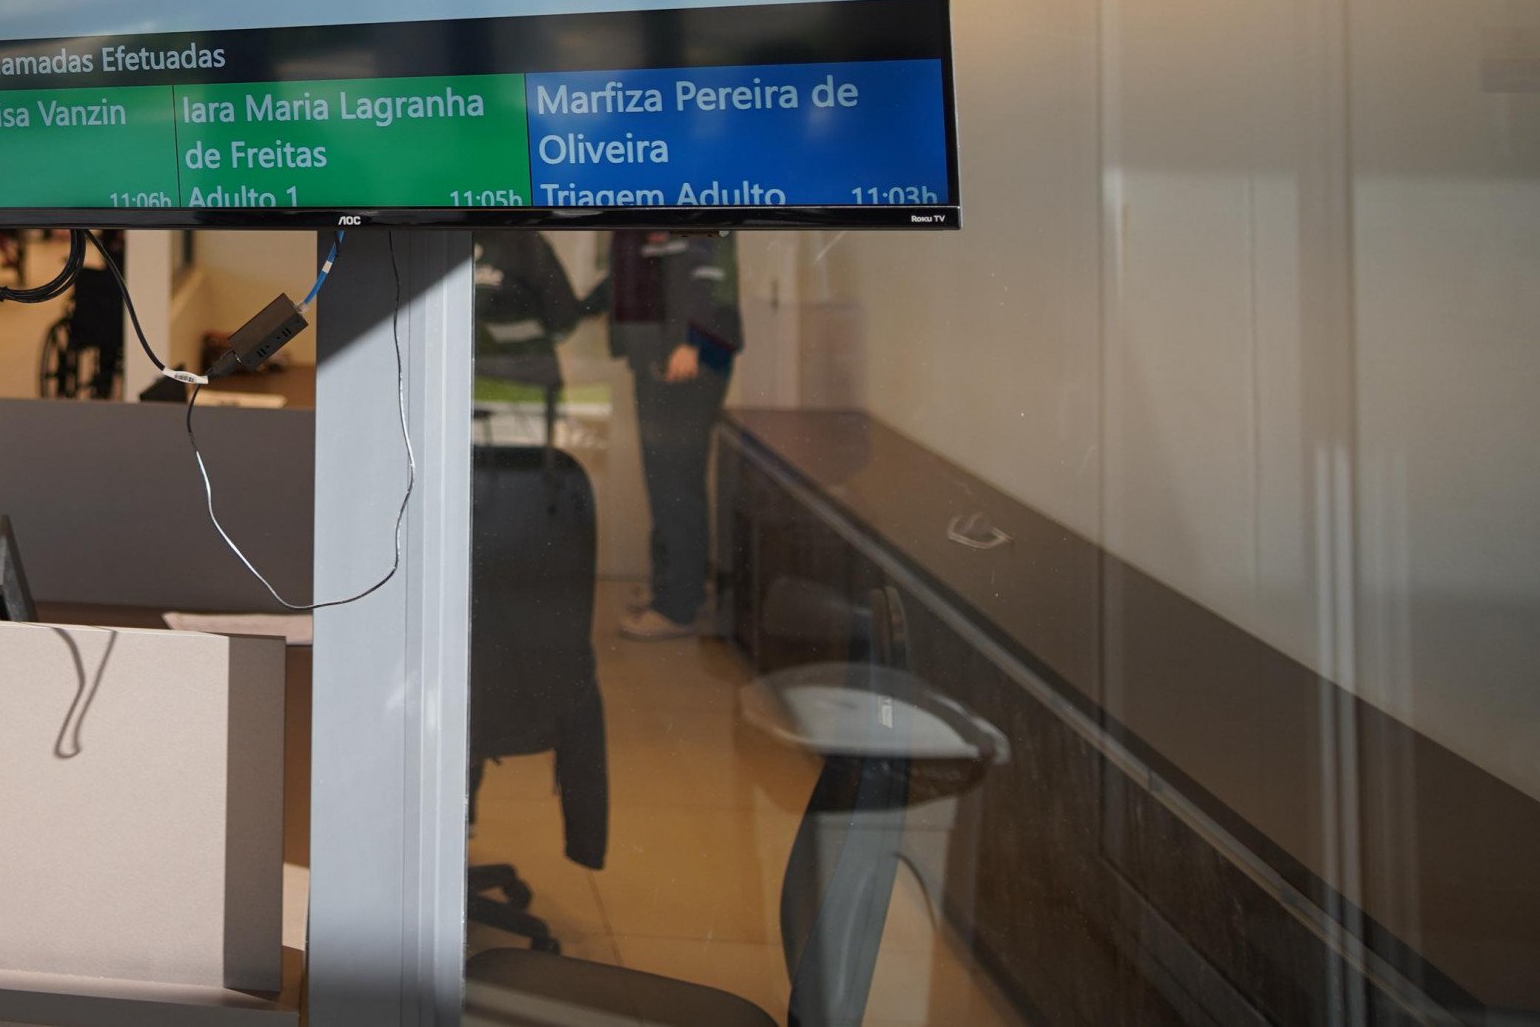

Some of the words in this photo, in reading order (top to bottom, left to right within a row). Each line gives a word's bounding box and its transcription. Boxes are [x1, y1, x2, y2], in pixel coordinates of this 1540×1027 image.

[102, 43, 226, 71] Efetuadas
[182, 95, 236, 124] Iara
[245, 92, 329, 122] Maria
[340, 87, 484, 127] Lagranha
[537, 81, 663, 114] Marfiza
[676, 79, 798, 111] Pereira
[811, 74, 858, 108] de
[37, 98, 126, 126] Vanzin
[185, 141, 222, 169] de
[230, 140, 327, 169] Freitas
[539, 133, 669, 165] Oliveira
[188, 186, 276, 207] Adulto
[286, 186, 298, 207] 1
[676, 181, 786, 206] Adulto
[338, 216, 361, 225] AOC
